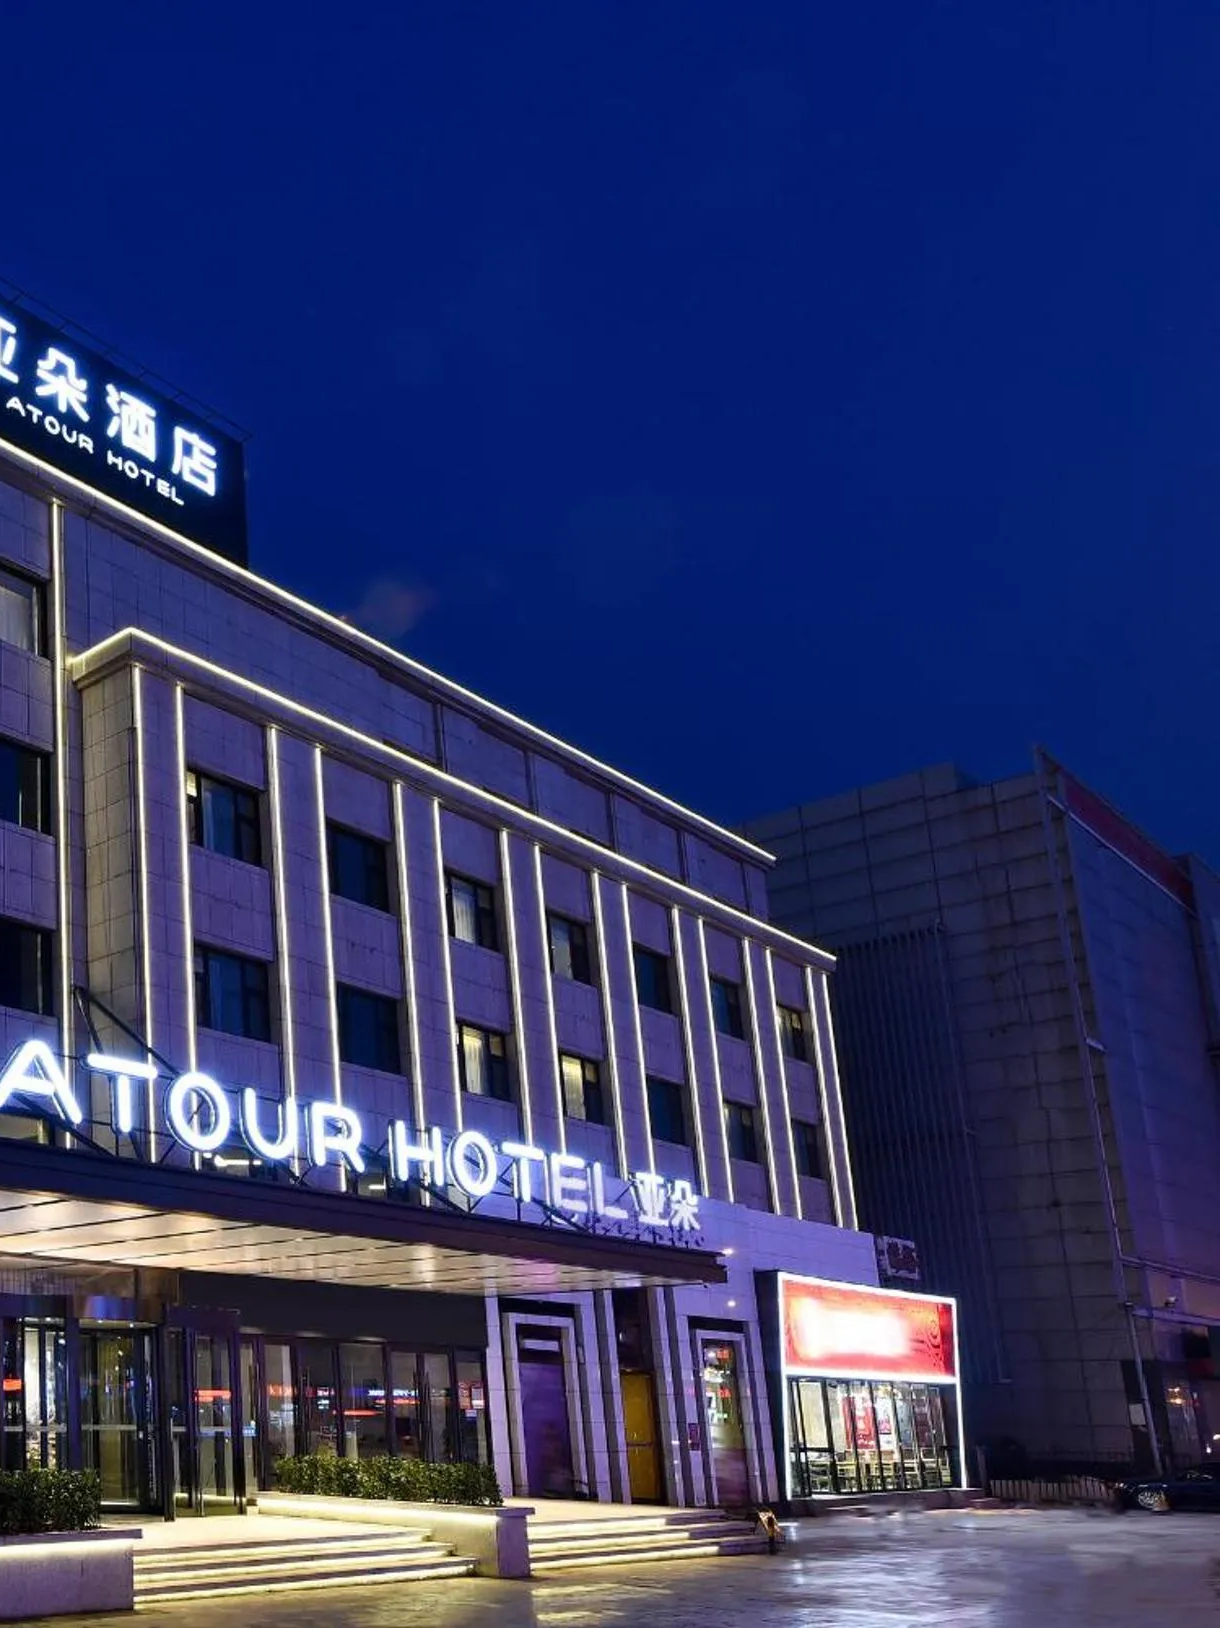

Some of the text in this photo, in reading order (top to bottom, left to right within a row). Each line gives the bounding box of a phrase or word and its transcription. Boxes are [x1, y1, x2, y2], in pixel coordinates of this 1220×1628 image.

[5, 395, 185, 507] ATOUR HOTEL
[388, 1119, 629, 1220] HOTEL
[630, 1171, 701, 1231] 亚朵
